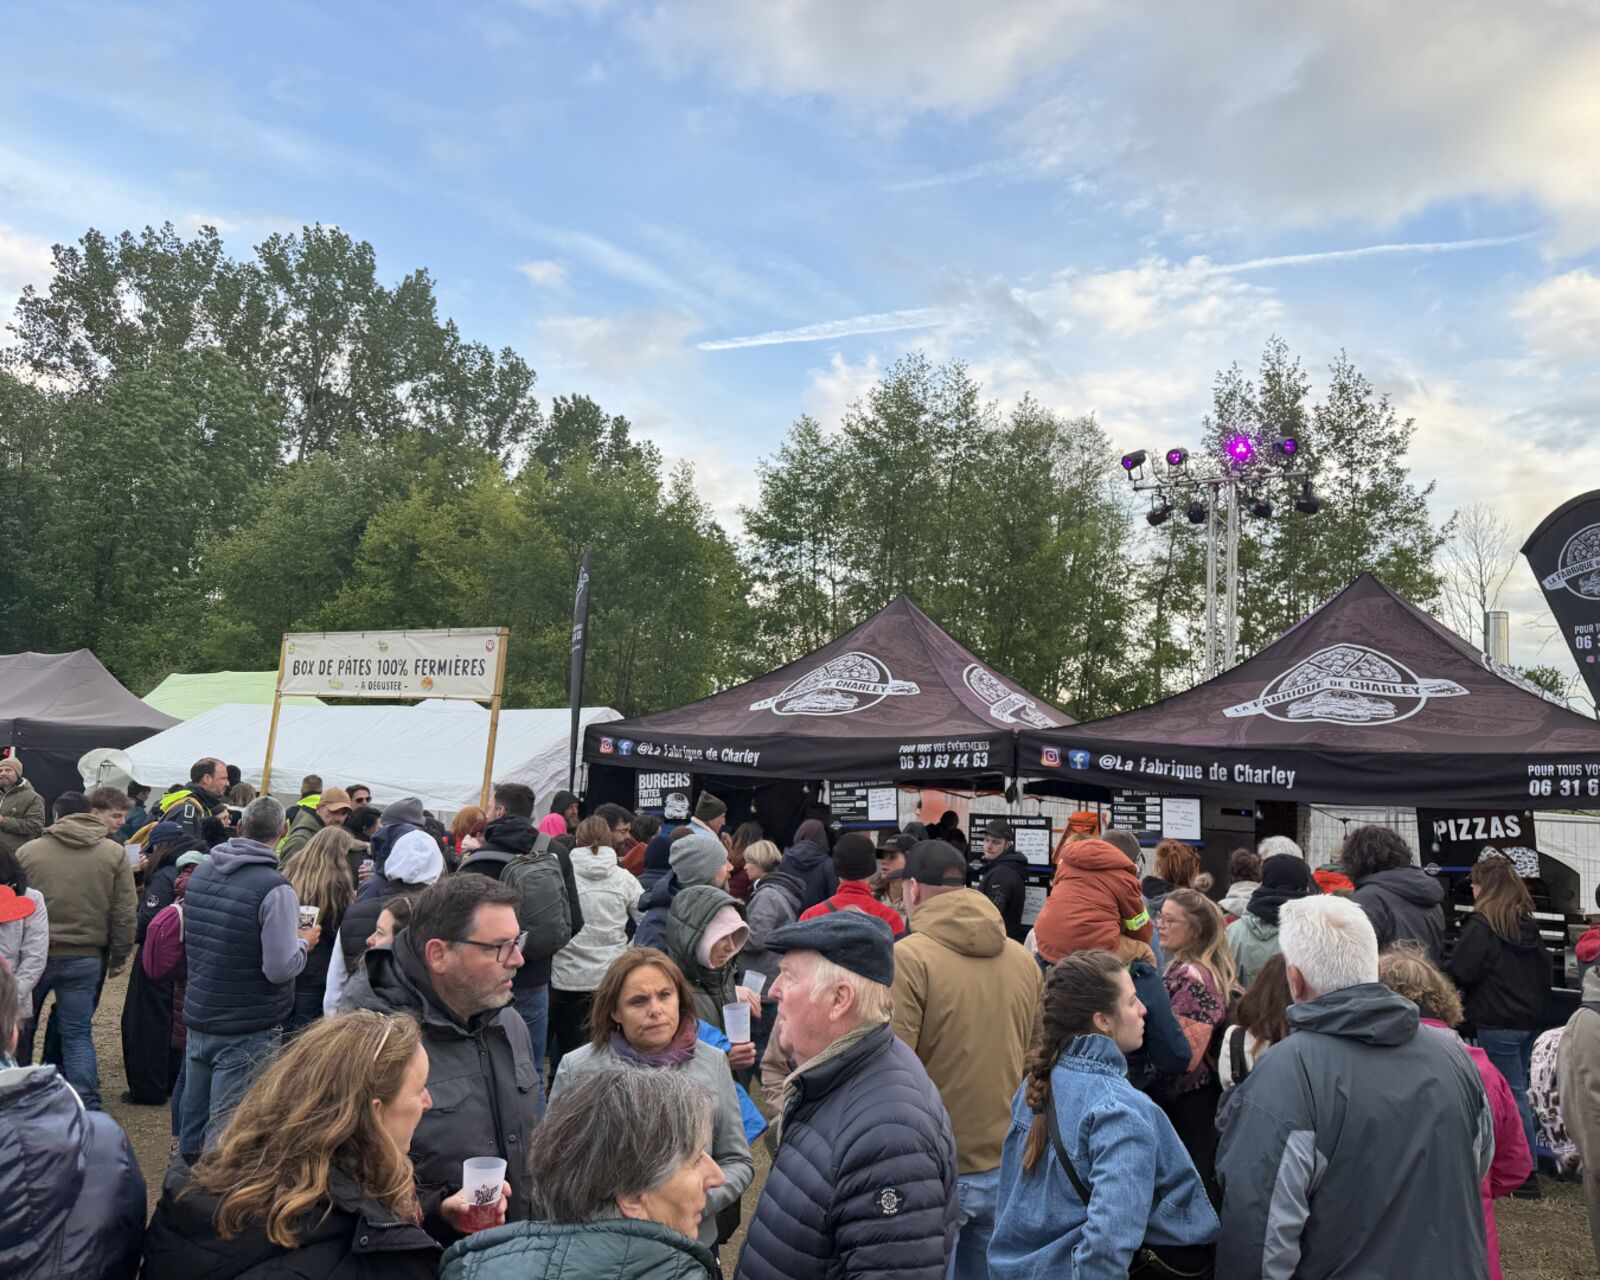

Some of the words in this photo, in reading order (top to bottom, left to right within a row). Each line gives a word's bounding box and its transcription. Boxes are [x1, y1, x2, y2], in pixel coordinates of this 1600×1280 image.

[1556, 561, 1594, 582] FABRIQUE
[1574, 624, 1594, 634] POUR
[1575, 635, 1592, 649] 06
[293, 659, 313, 676] BOX
[318, 659, 333, 676] DE
[337, 655, 372, 676] PÂTES
[377, 659, 408, 676] 100%
[414, 654, 486, 677] FERMIÈRES
[367, 678, 402, 691] DÉGUSTER
[835, 680, 888, 693] CHARLEY
[1234, 705, 1249, 713] LA
[1252, 681, 1325, 708] FABRIQUE
[1329, 681, 1345, 689] DE
[1349, 680, 1421, 696] CHARLEY
[899, 744, 916, 754] POUR
[917, 743, 932, 753] TOUS
[933, 742, 946, 753] VOS
[947, 740, 991, 753] ÉVÉNEMENTS
[705, 747, 718, 761] de
[721, 748, 760, 767] Charley
[900, 755, 914, 770] 06
[918, 755, 931, 769] 31
[934, 754, 949, 769] 63
[952, 753, 969, 768] 44
[973, 752, 988, 768] 63
[1099, 754, 1133, 771] @La
[1139, 757, 1203, 780] fabrique
[1209, 762, 1228, 781] de
[1234, 764, 1296, 789] Charley
[1528, 765, 1554, 777] POUR
[1556, 764, 1582, 776] TOUS
[1585, 763, 1600, 776] VO
[638, 772, 690, 789] BURGERS
[1529, 779, 1552, 796] 06
[1560, 779, 1580, 796] 31
[638, 788, 661, 798] FRITES
[638, 797, 662, 807] MAISON
[1433, 815, 1521, 842] PIZZAS
